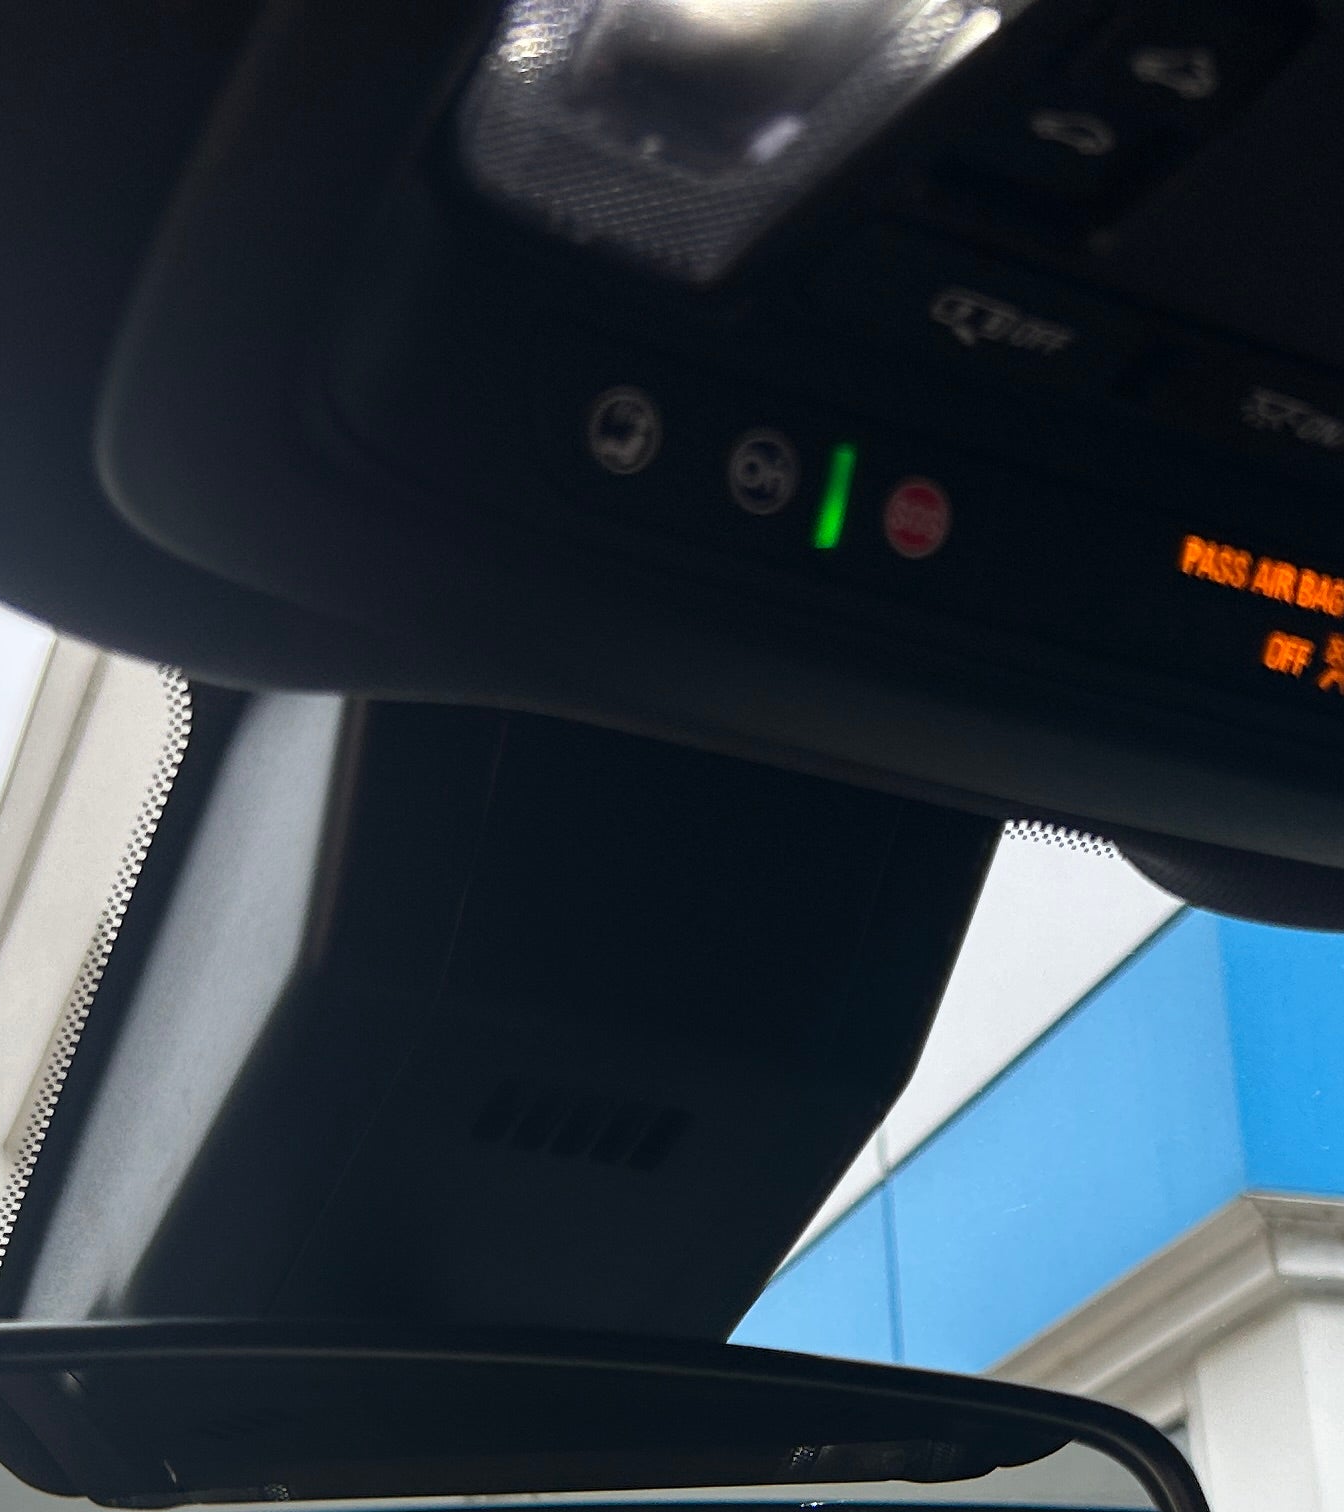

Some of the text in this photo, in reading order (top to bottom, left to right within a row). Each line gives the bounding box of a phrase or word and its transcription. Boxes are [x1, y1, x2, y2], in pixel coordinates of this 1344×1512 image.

[1180, 534, 1253, 590] PASS
[1251, 557, 1299, 605] AIR
[1261, 629, 1315, 677] OFF
